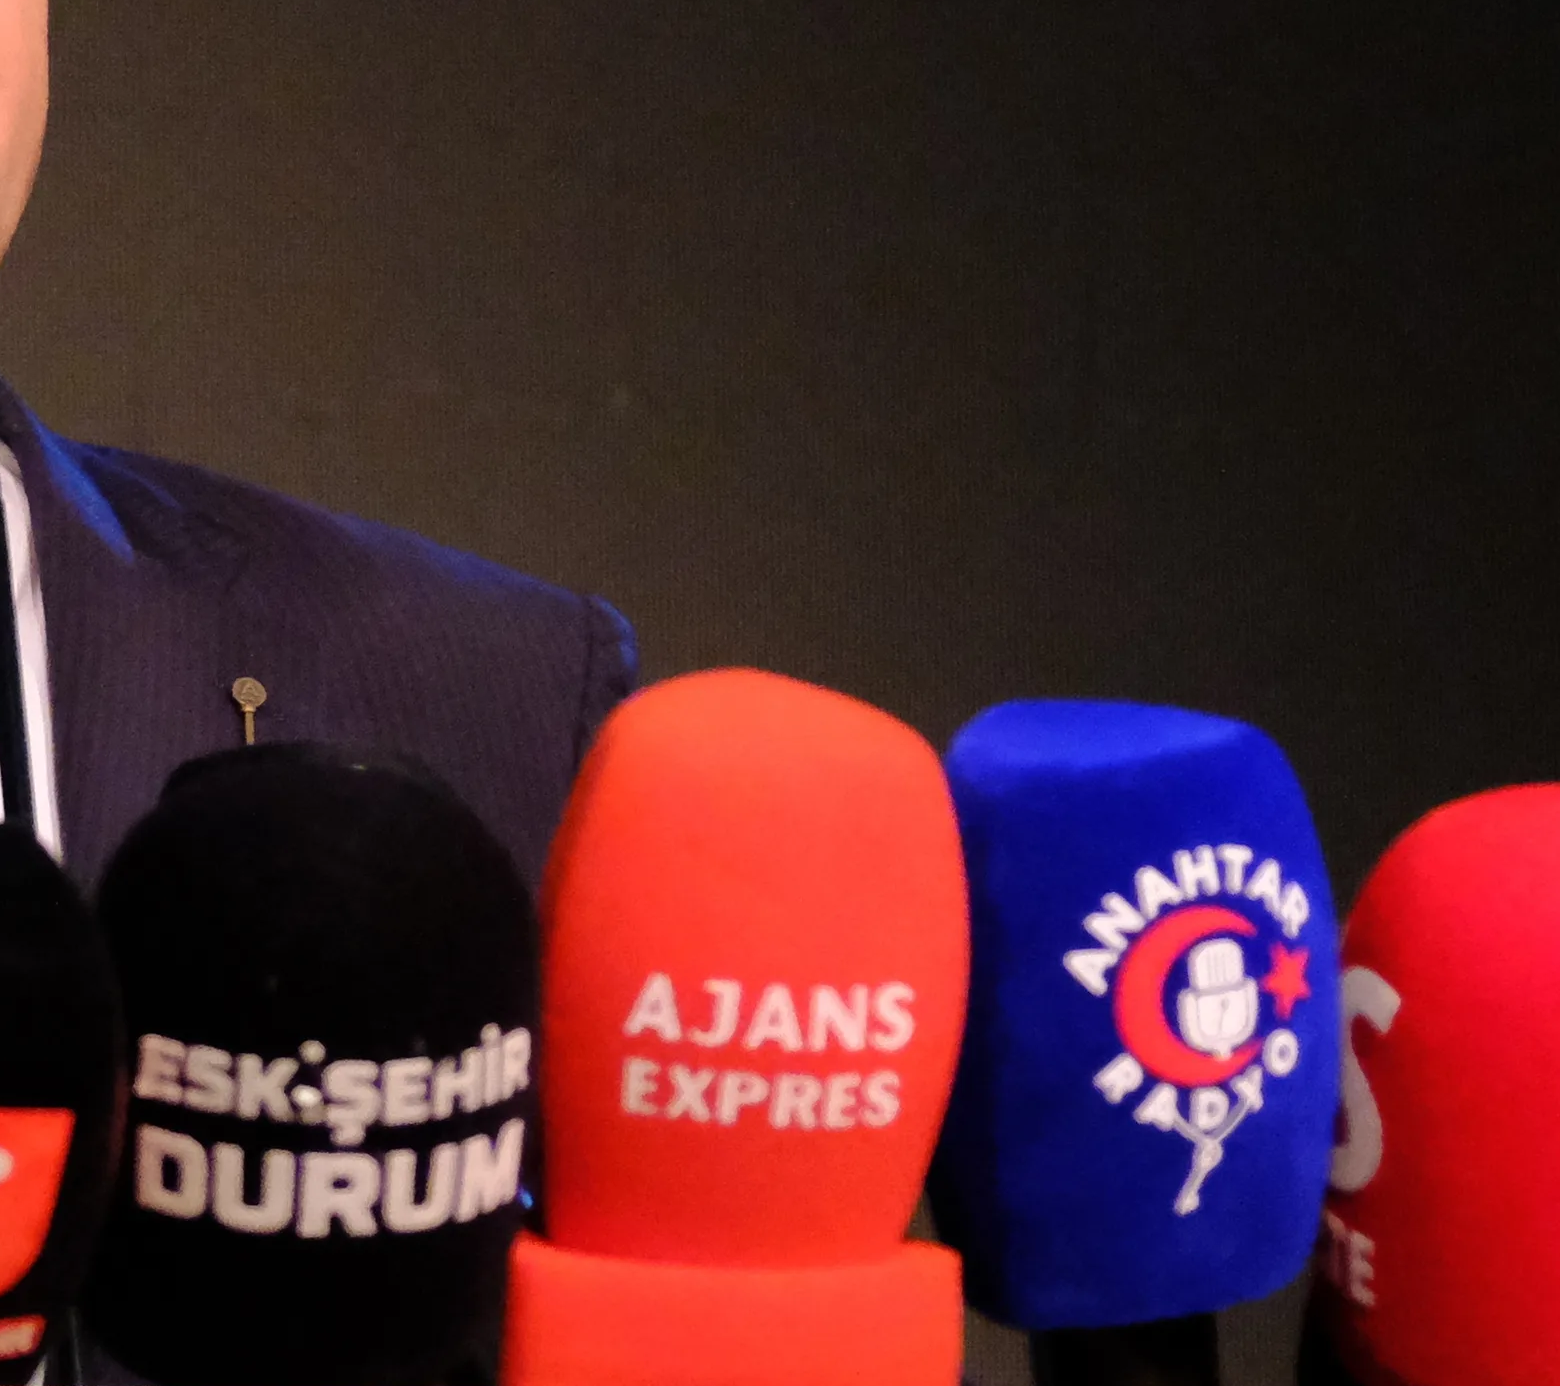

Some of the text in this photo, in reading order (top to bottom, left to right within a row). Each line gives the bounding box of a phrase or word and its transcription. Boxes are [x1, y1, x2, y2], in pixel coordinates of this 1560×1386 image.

[1062, 843, 1310, 997] ANAHTAR
[622, 970, 916, 1053] AJANS
[620, 1057, 901, 1131] EXPRES
[135, 1116, 525, 1239] DURUM
